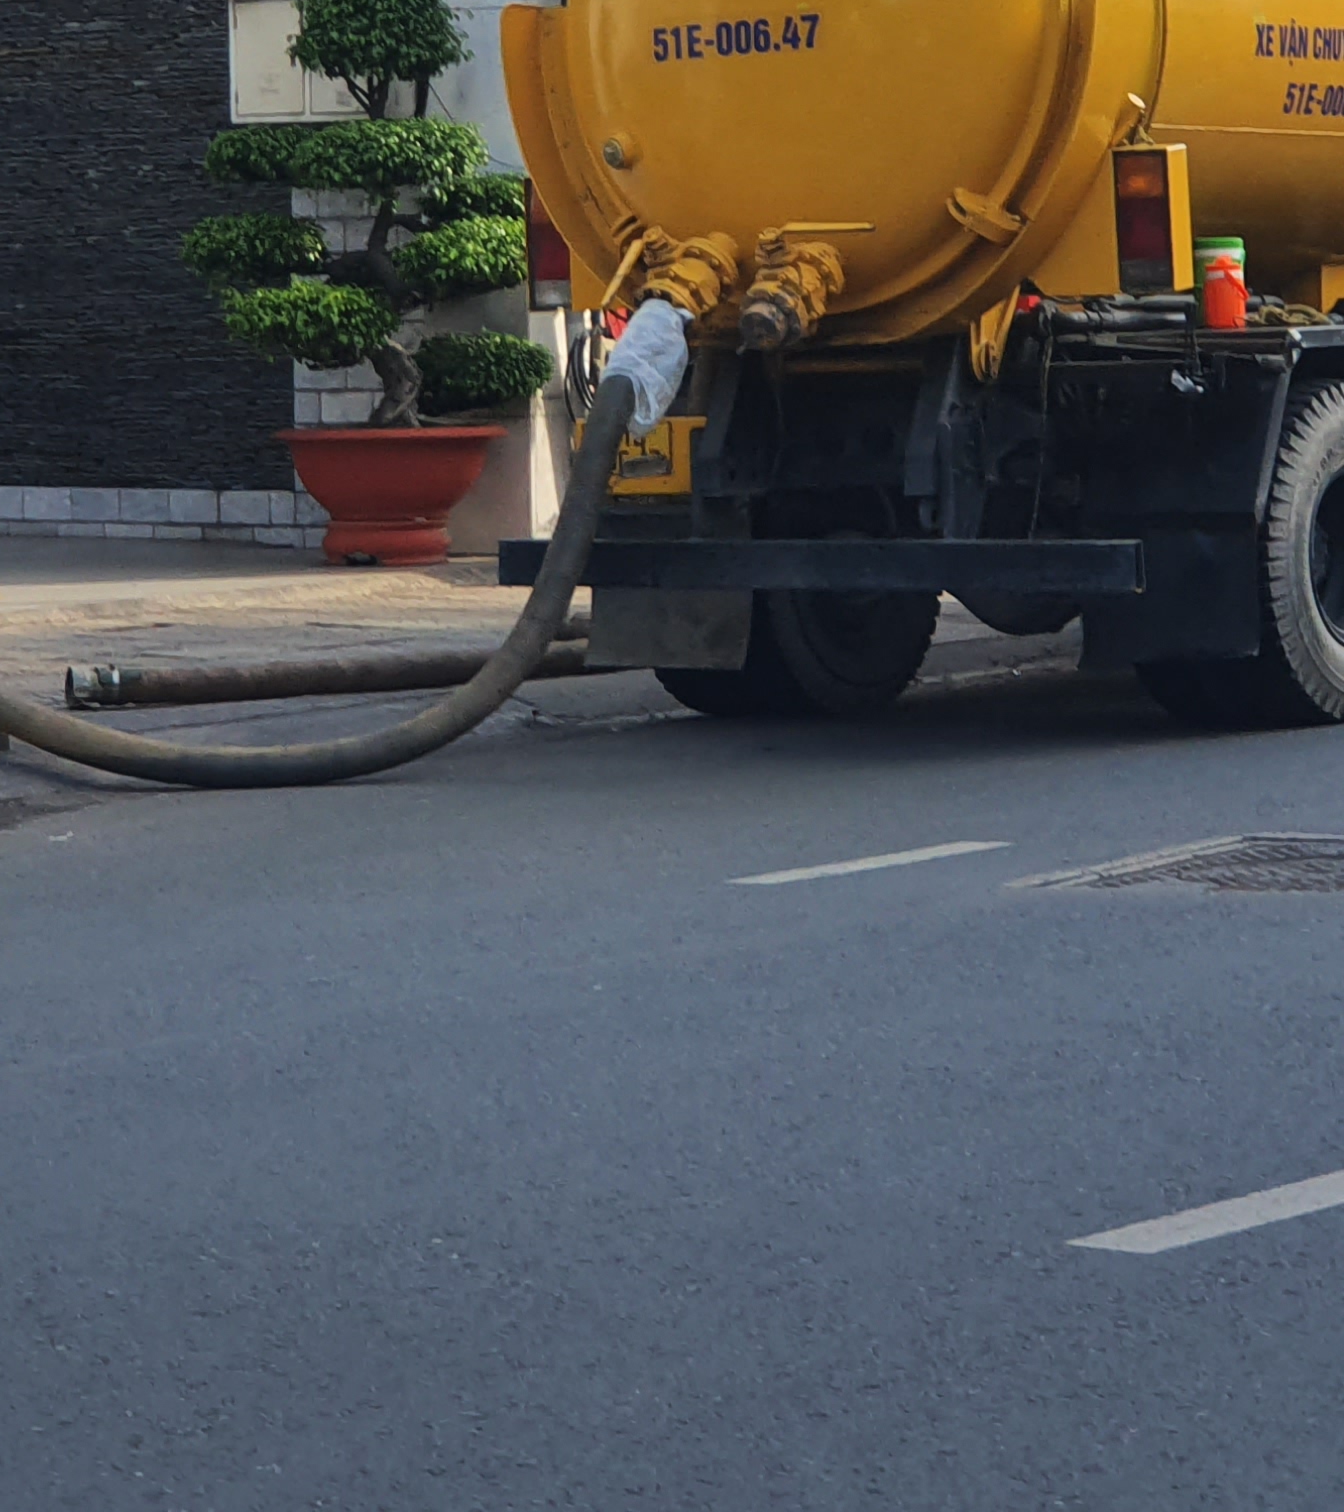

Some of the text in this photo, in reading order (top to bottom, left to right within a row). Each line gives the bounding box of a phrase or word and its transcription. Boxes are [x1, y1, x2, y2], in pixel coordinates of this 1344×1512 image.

[652, 12, 820, 64] 51E-006.47
[1255, 23, 1275, 58] XE
[1278, 17, 1309, 67] VẬN
